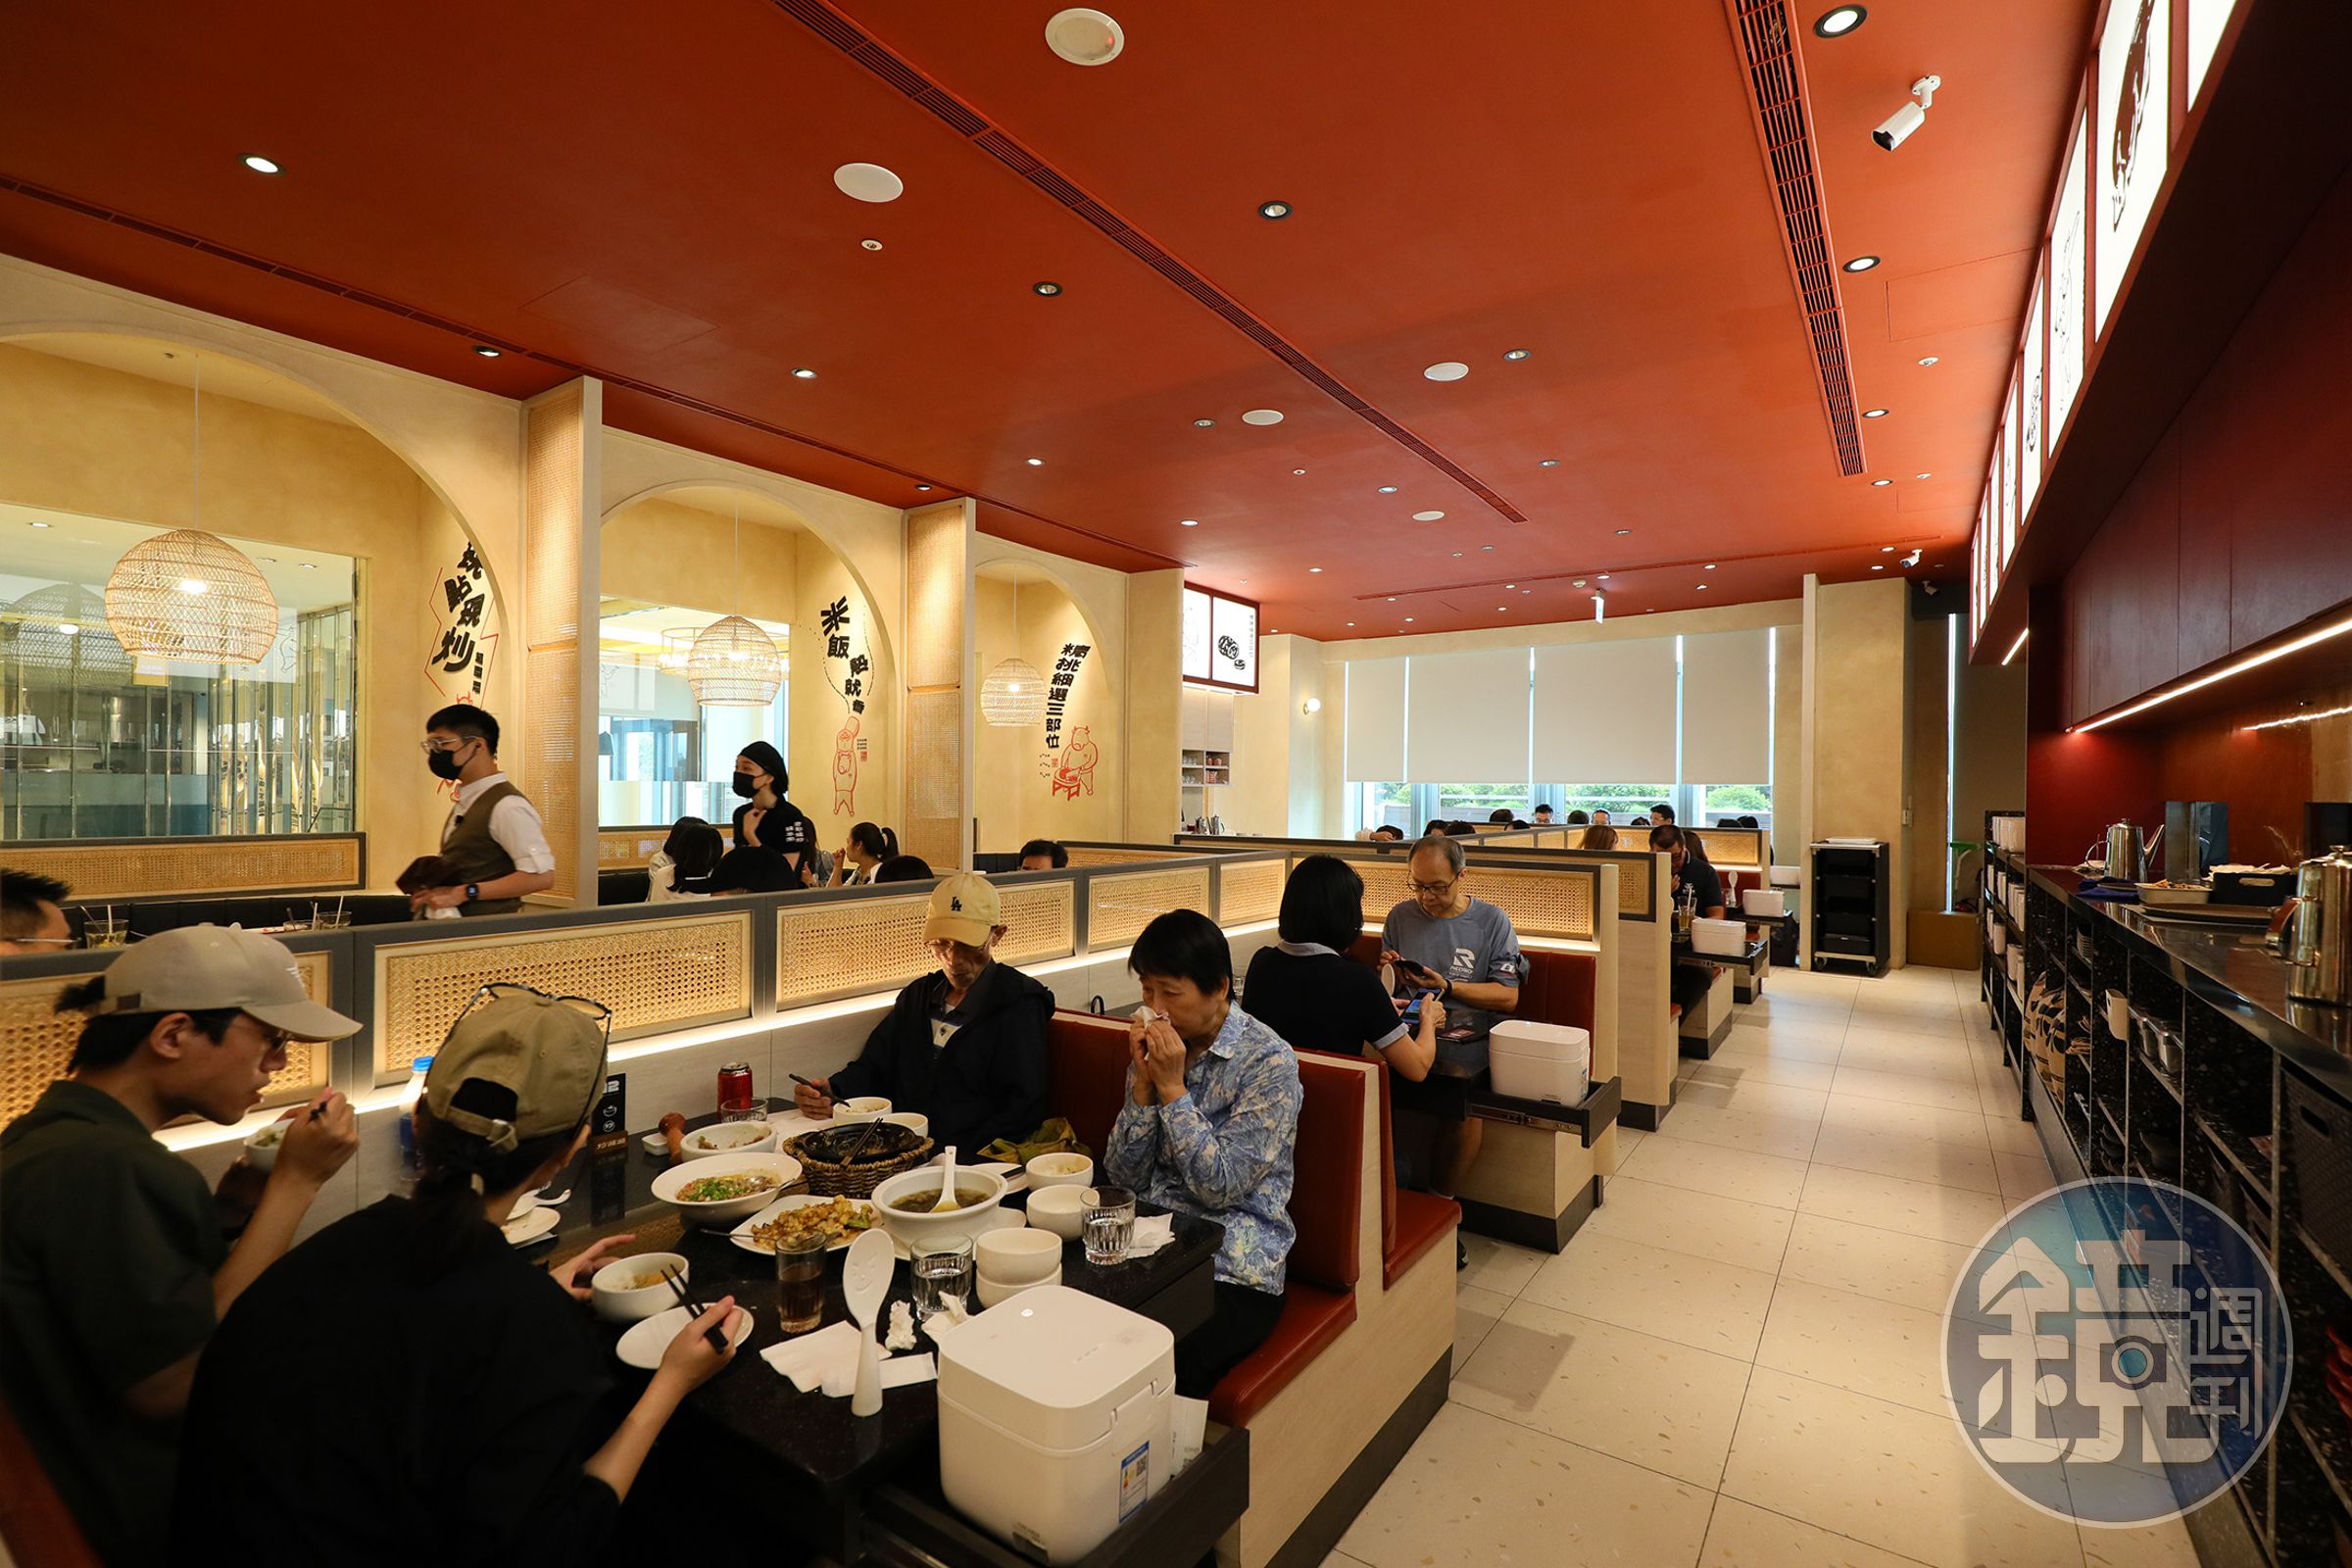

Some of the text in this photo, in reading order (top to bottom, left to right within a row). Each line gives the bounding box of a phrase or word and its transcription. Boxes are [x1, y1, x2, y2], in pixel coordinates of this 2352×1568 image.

[1046, 643, 1092, 749] 精挑細選三部位
[950, 896, 962, 911] LA
